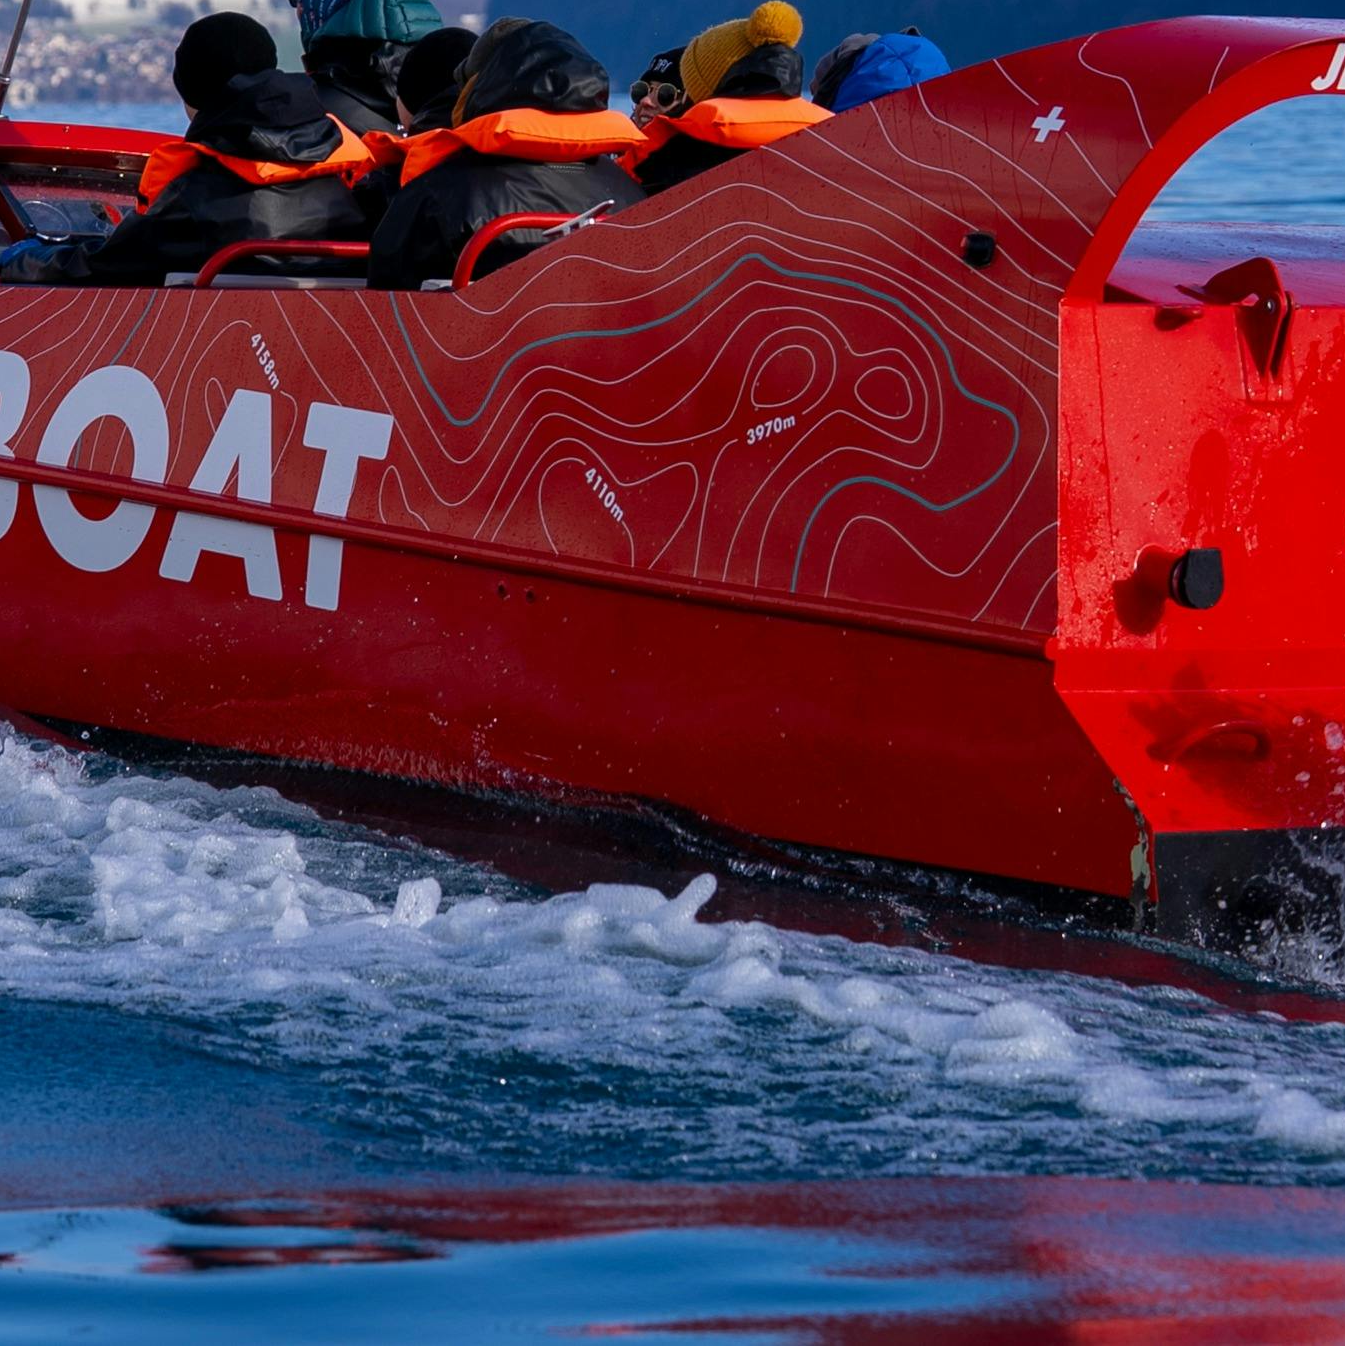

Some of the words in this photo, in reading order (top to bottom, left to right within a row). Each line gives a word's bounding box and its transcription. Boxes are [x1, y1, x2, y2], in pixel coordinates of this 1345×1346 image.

[251, 333, 280, 390] 4158m
[746, 414, 797, 446] 3970m
[584, 467, 625, 522] 4110m
